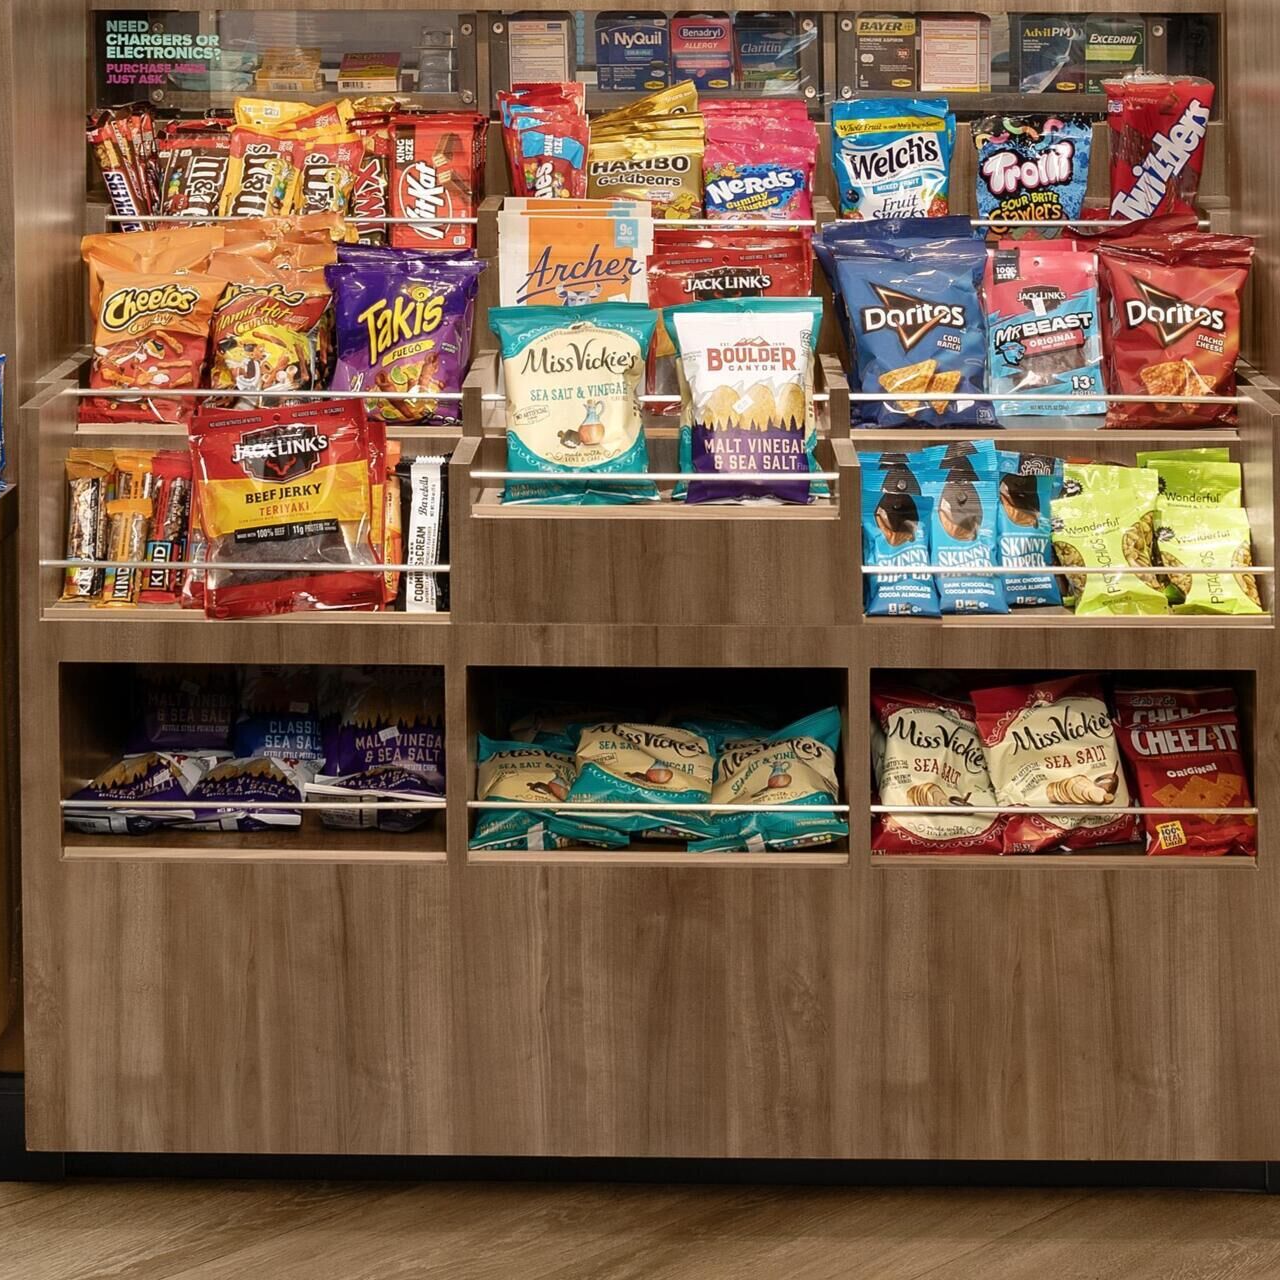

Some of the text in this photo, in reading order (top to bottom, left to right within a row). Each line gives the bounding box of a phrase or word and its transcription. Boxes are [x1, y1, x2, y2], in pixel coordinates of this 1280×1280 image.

[106, 20, 149, 32] NEED
[682, 27, 721, 39] Benadryl
[858, 21, 903, 32] BAYER
[1023, 27, 1052, 38] Advil
[106, 34, 219, 47] CHARGERS OR
[614, 31, 662, 48] NyQuil
[740, 42, 782, 54] Claritin
[106, 47, 222, 61] ELECTRONICS?
[106, 64, 172, 73] PURCHASE
[106, 75, 166, 85] JUST ASK.
[396, 139, 405, 163] KING
[405, 138, 414, 161] SIZE
[591, 155, 689, 174] HARIBO
[847, 136, 939, 181] Welch's
[984, 141, 1072, 193] Trolli
[598, 173, 681, 187] Goldbears
[876, 183, 898, 192] MIXED
[882, 195, 918, 212] Fruit
[1001, 192, 1030, 209] SOUR
[517, 244, 642, 288] Archer
[685, 275, 771, 293] JACK LINK'S
[1040, 291, 1066, 300] LINK'S
[103, 285, 197, 331] Cheetos
[1126, 302, 1224, 330] Doritos
[864, 306, 965, 331] Doritos
[358, 292, 445, 365] Takis
[943, 335, 961, 345] COOL
[1029, 332, 1077, 347] ORIGINAL
[390, 343, 424, 361] FUEGO
[521, 338, 639, 375] Miss Vickie's
[707, 347, 797, 371] BOULDER
[530, 387, 585, 401] SEA SALT &
[277, 434, 329, 456] LINK'S
[704, 438, 742, 454] MALT
[714, 455, 797, 470] & SEA SALT
[246, 483, 322, 504] BEEF JERKY
[1166, 493, 1220, 503] Wonderful
[259, 501, 310, 517] TERIYAKI
[1065, 518, 1120, 535] Wonderful
[1000, 536, 1049, 557] SKINNY
[938, 546, 992, 567] SKINNY
[889, 716, 940, 749] Miss
[1013, 726, 1061, 756] Miss
[265, 735, 290, 749] SEA
[599, 740, 617, 750] SEA
[376, 747, 441, 762] SEA SALT
[1044, 744, 1107, 770] SEA SALT
[913, 758, 939, 773] SEA
[941, 763, 962, 785] SALT
